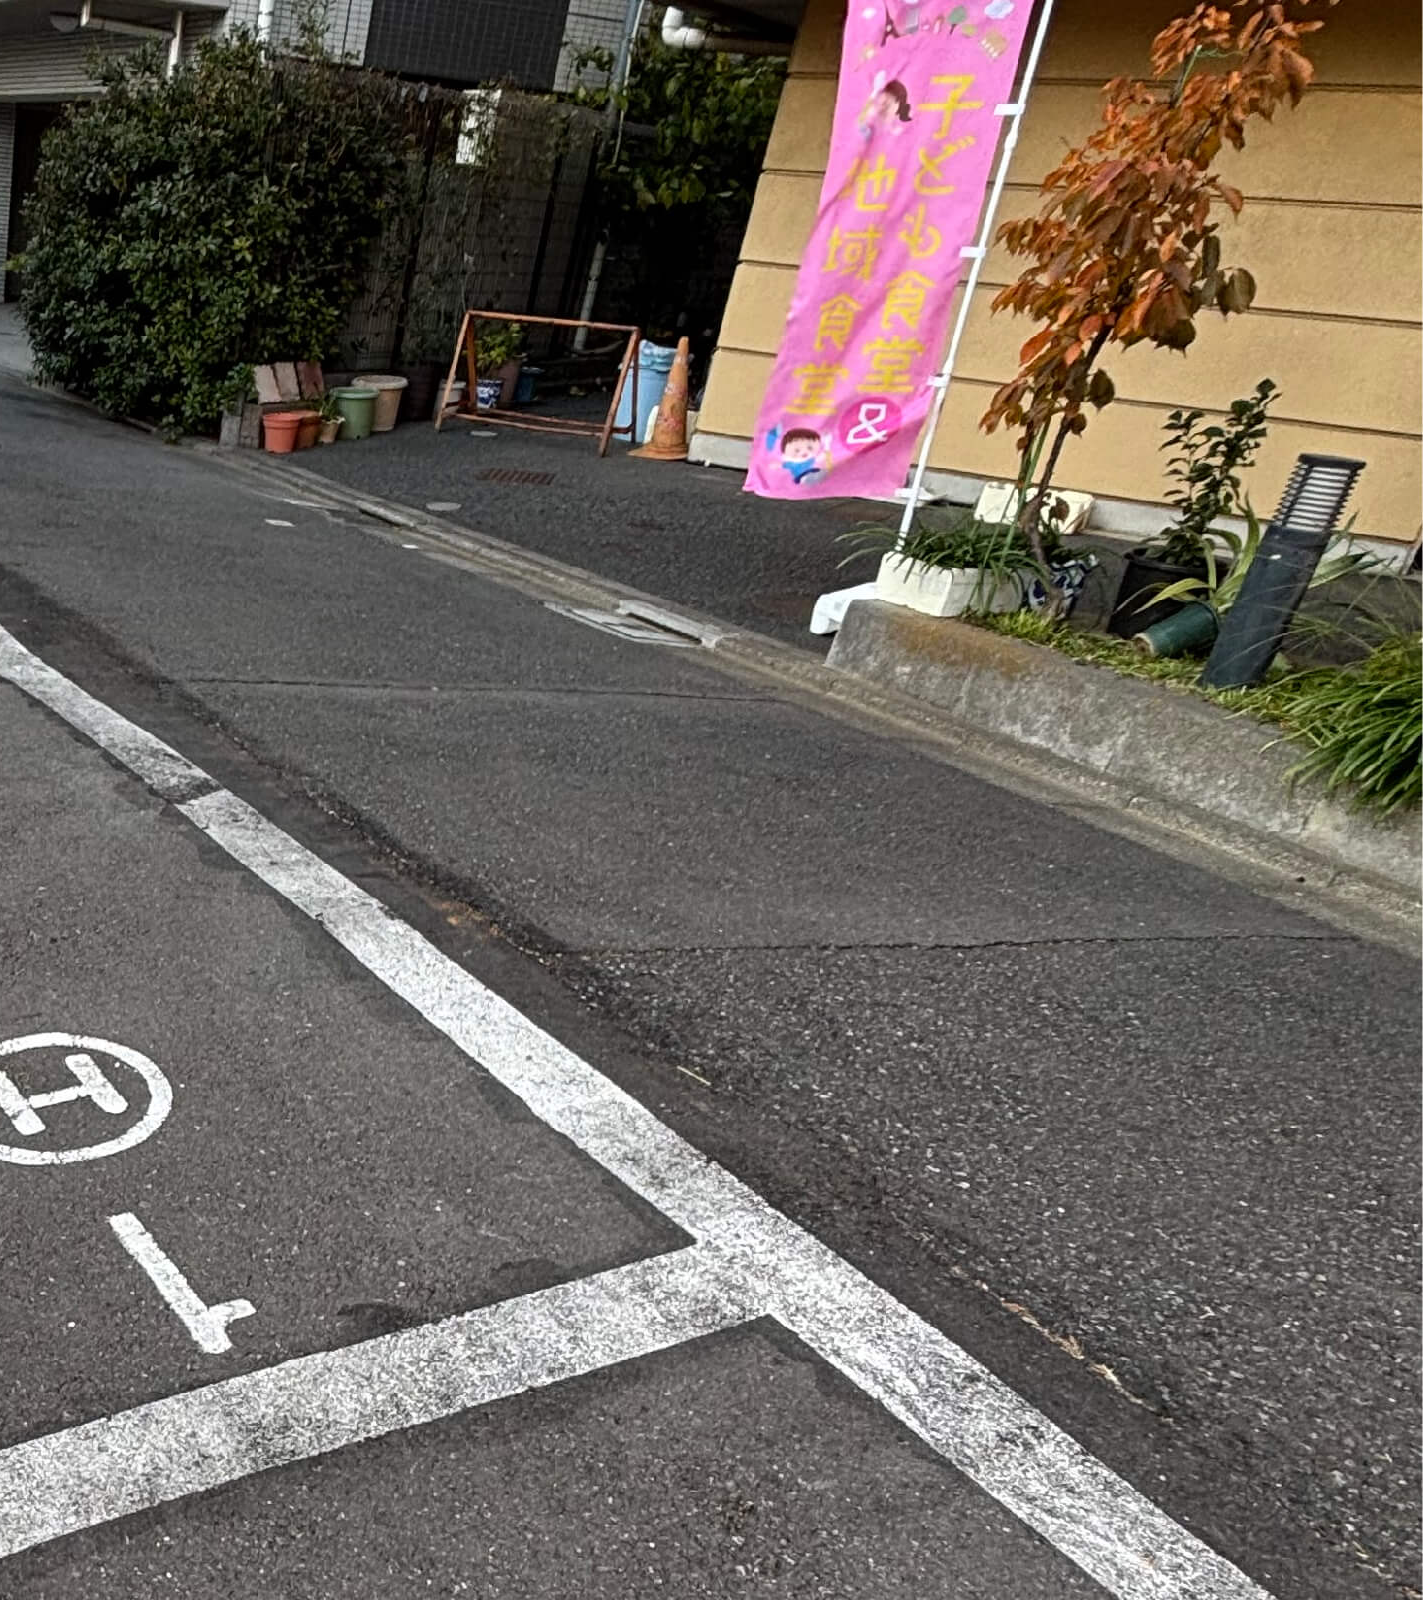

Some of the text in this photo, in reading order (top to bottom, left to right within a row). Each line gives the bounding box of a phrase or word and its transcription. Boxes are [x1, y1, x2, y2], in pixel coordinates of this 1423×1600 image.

[784, 153, 897, 416] 地域食堂
[857, 75, 984, 394] 子ども食堂
[107, 1211, 257, 1355] 1
